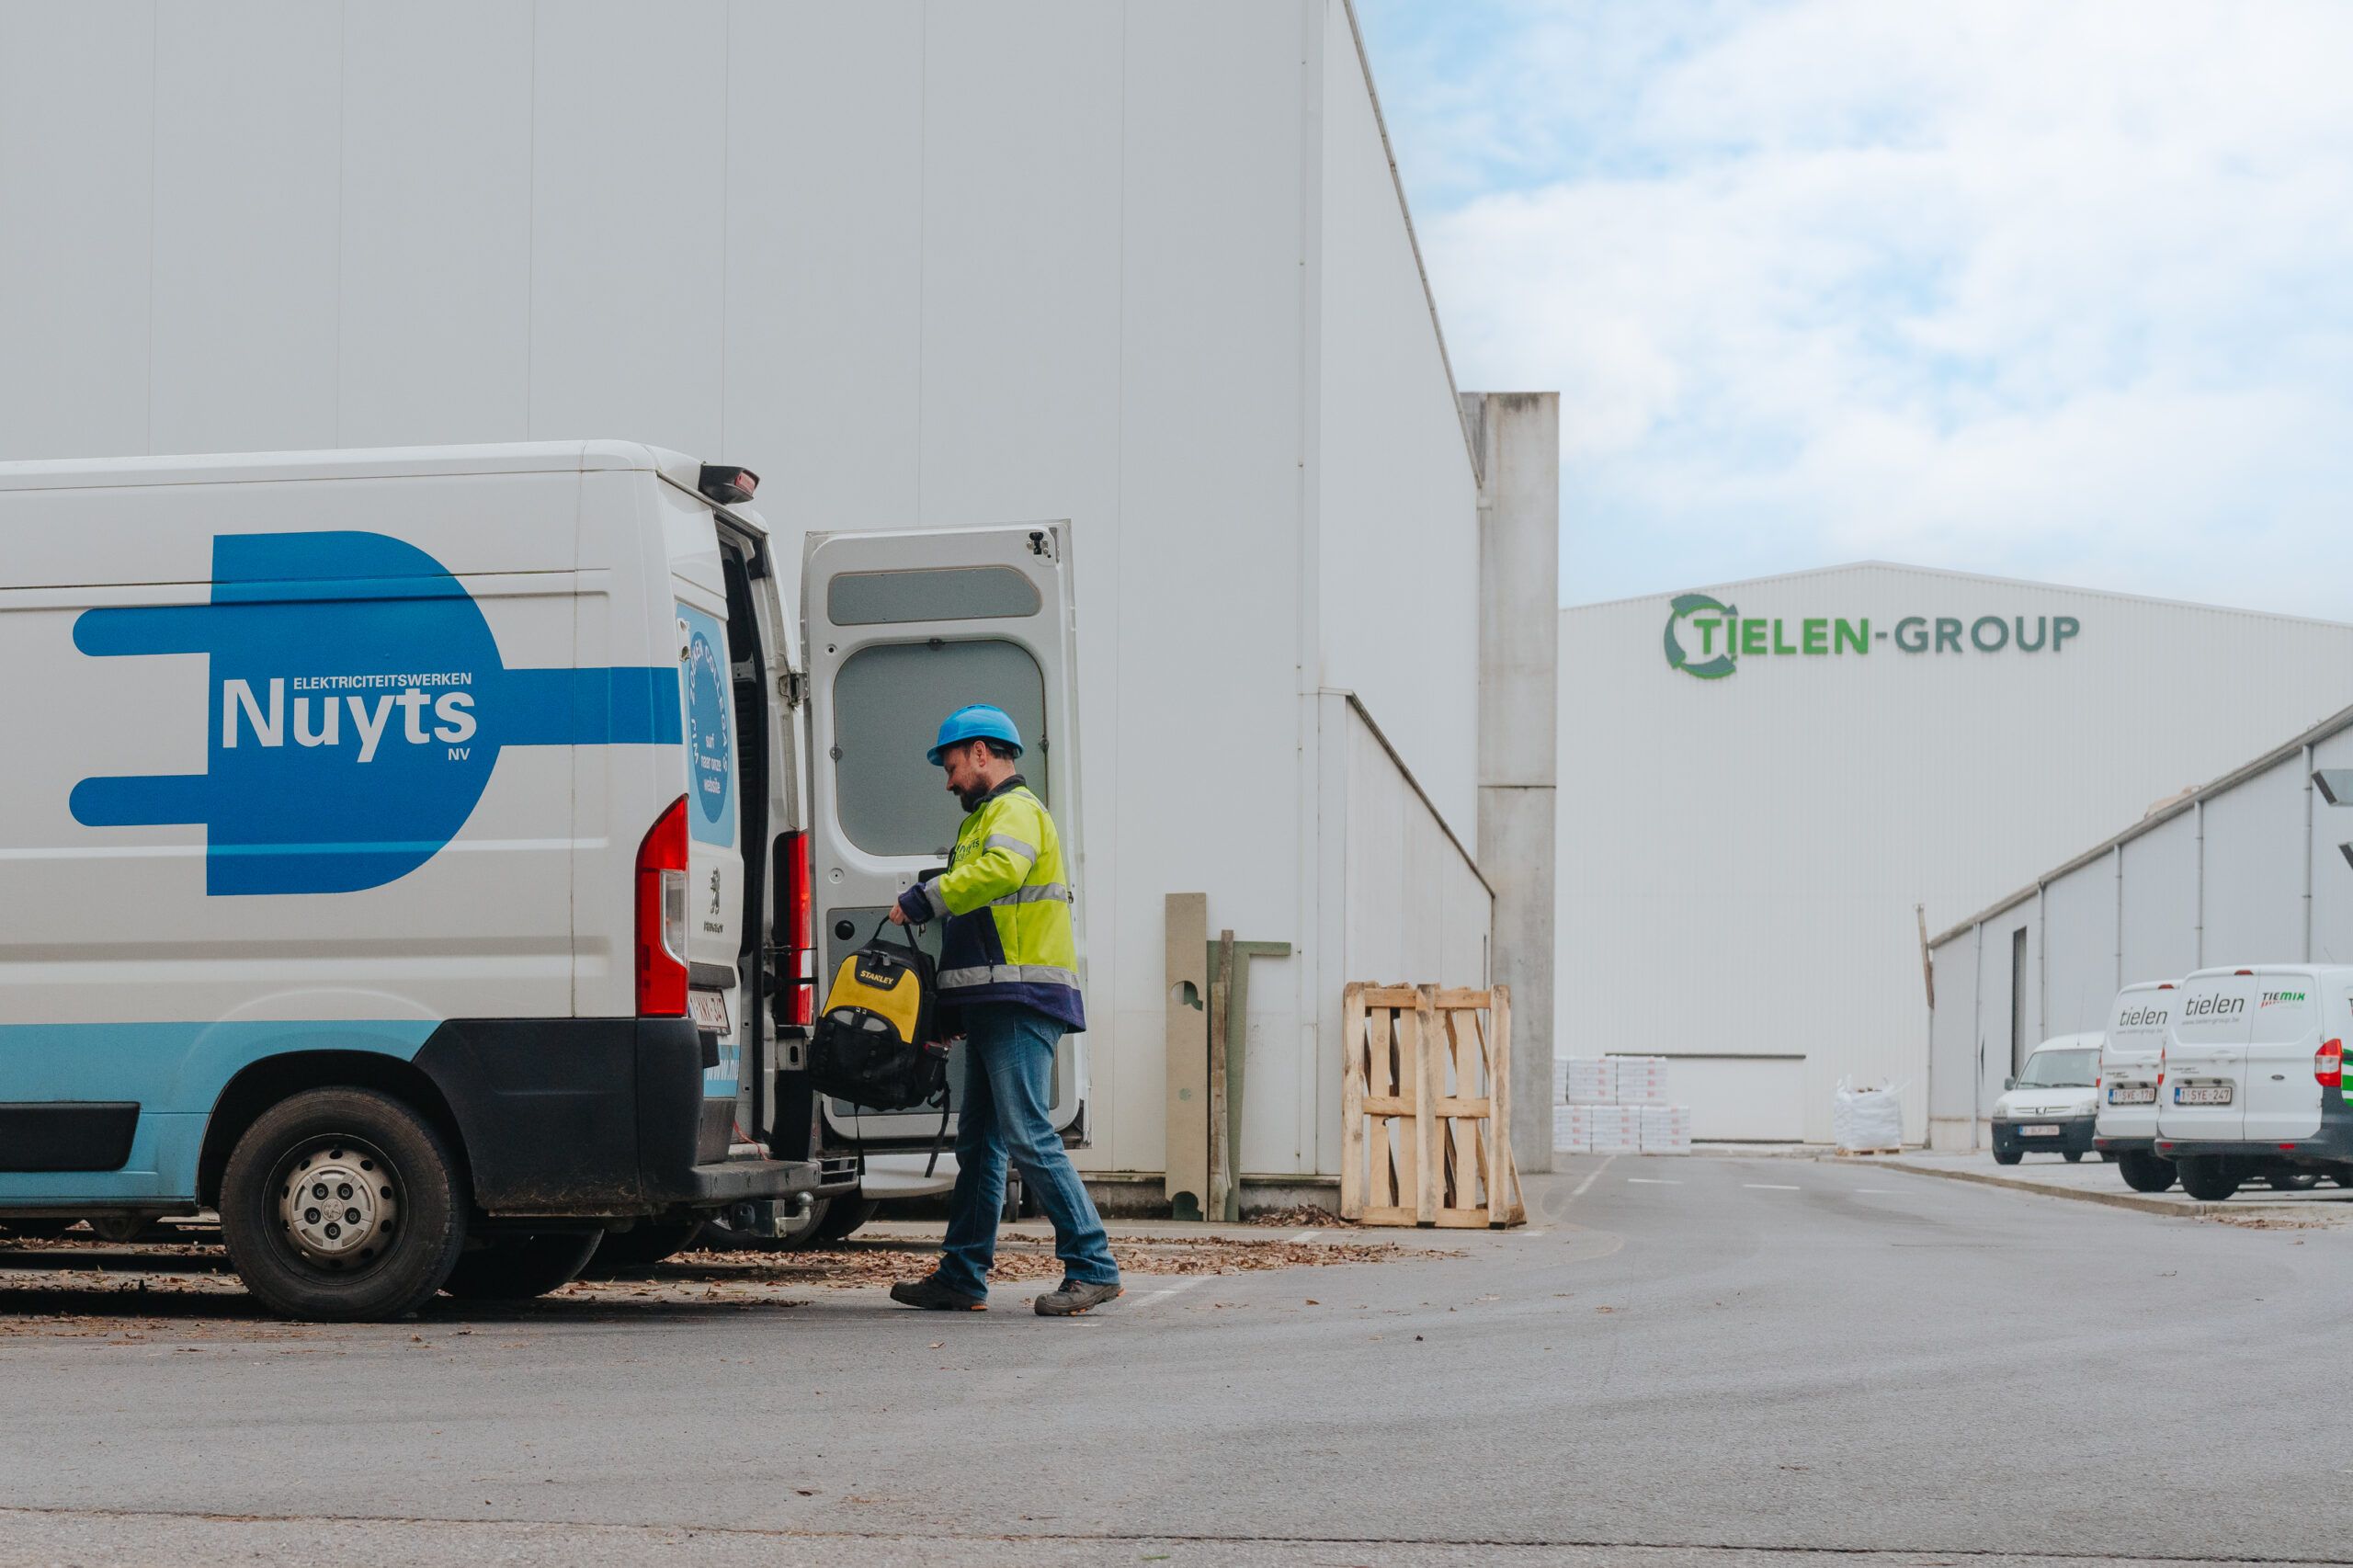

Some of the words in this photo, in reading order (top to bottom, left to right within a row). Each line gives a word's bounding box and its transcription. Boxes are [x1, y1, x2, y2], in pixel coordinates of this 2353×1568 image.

[293, 672, 472, 690] ELEKTRICITEITSWERKEN
[222, 677, 478, 763] Nuyts
[448, 747, 471, 761] NV
[859, 970, 893, 984] STANLEY
[2185, 993, 2245, 1016] tielen
[2120, 1006, 2167, 1026] tielen
